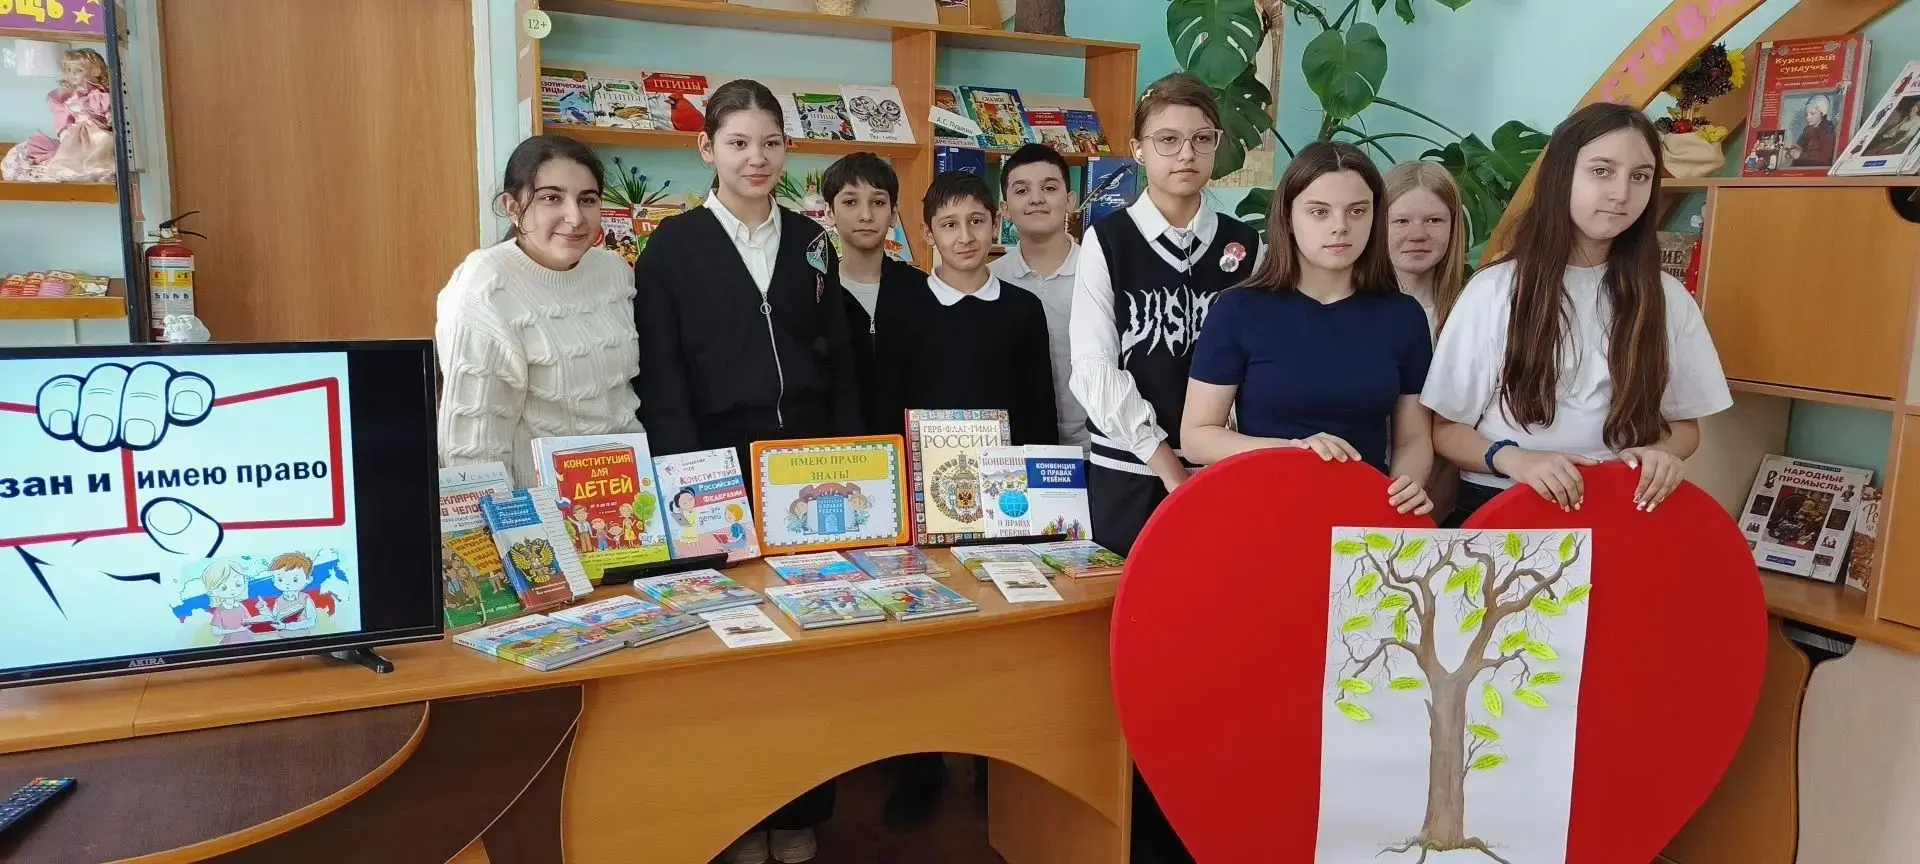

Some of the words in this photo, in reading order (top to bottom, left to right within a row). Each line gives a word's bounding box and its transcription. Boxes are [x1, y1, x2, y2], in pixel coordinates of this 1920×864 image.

[527, 18, 547, 30] 12+
[653, 79, 702, 91] ПТИЦЫ
[923, 434, 998, 449] РОССИИ
[563, 453, 632, 469] КОНСТИТУЦИЯ
[790, 457, 828, 467] ИМЕЮ
[830, 454, 867, 465] ПРАВО
[1035, 463, 1076, 471] КОНВЕНЦИЯ
[137, 465, 227, 490] имею
[236, 460, 328, 488] право
[591, 467, 609, 478] ДЛЯ
[810, 469, 849, 480] ЗНАТЬ!
[1783, 467, 1845, 483] НАРОДНЫЕ
[0, 474, 73, 498] зан
[87, 472, 112, 493] и
[573, 474, 633, 500] ДЕТЕЙ
[1779, 475, 1844, 492] ПРОМЫСЛЫ
[128, 657, 166, 668] AKIRA
